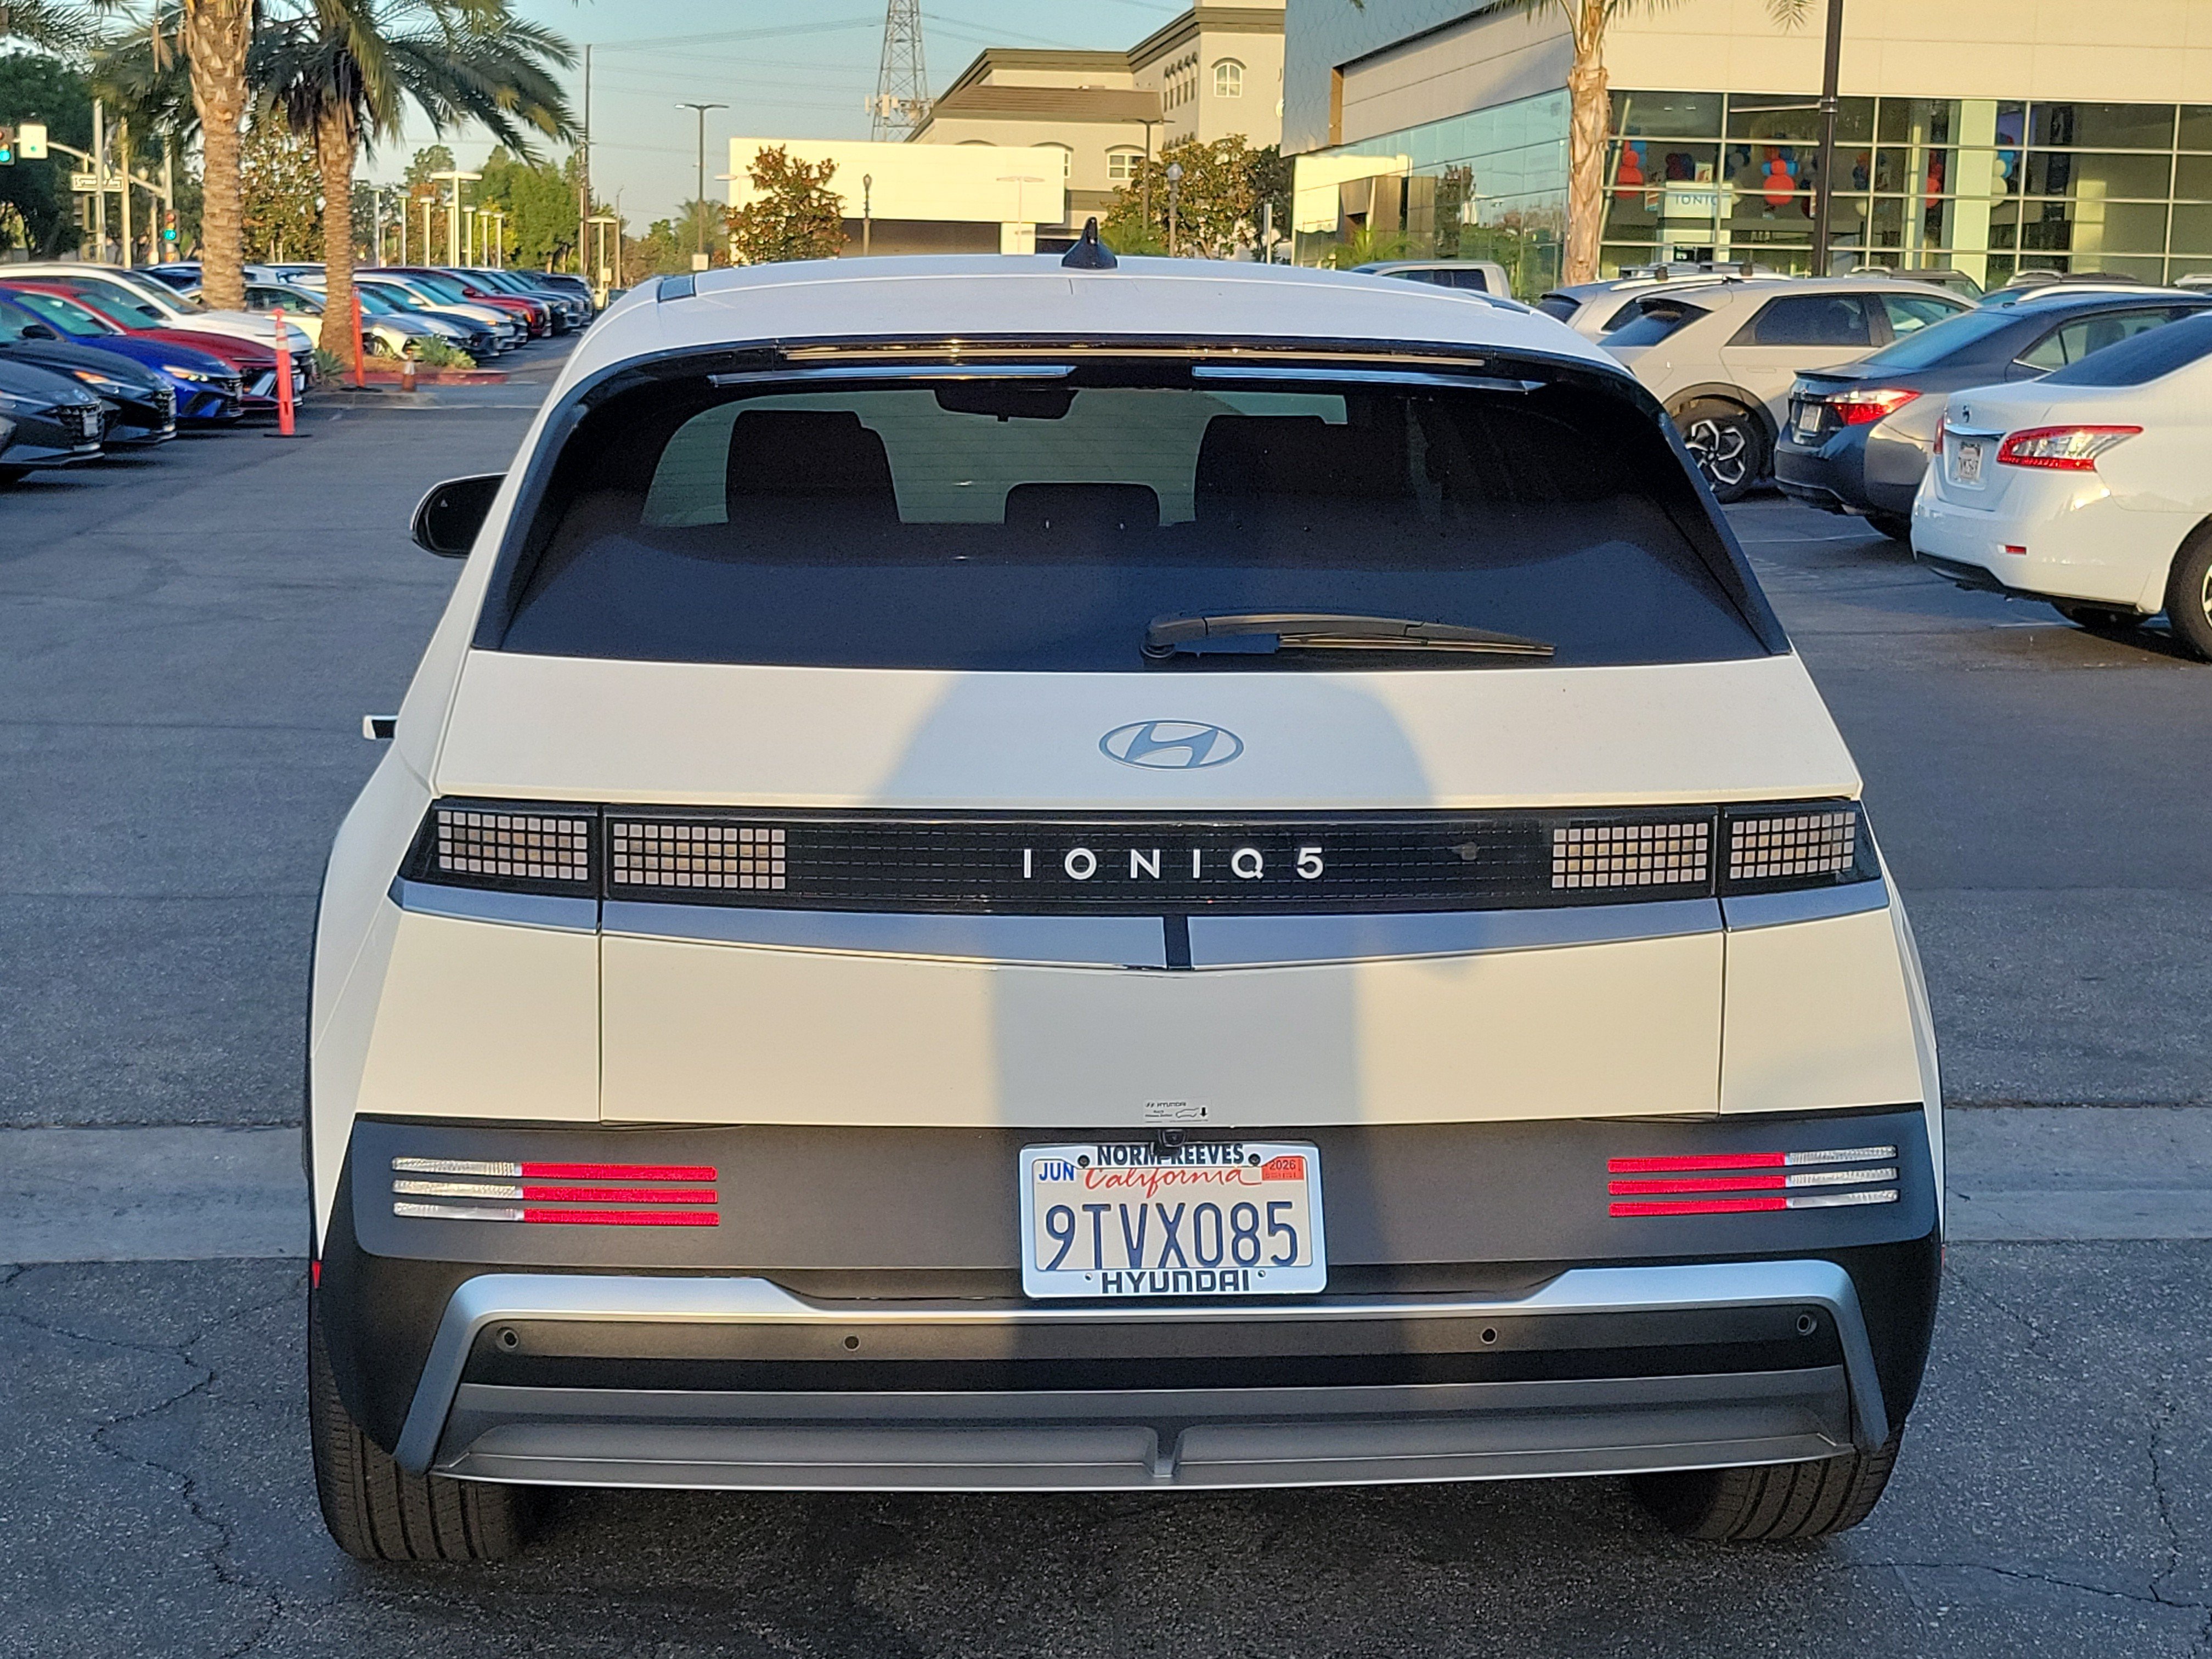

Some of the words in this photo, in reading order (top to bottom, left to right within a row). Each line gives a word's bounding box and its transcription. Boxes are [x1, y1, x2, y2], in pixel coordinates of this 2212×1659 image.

[1023, 848, 1263, 879] IONIQ
[1296, 847, 1324, 879] 5
[1039, 1161, 1074, 1181] JUN
[1269, 1159, 1296, 1170] 2026
[1086, 1166, 1261, 1198] California
[1046, 1201, 1299, 1270] 9TVX085
[1102, 1269, 1250, 1294] HYUNDAI
